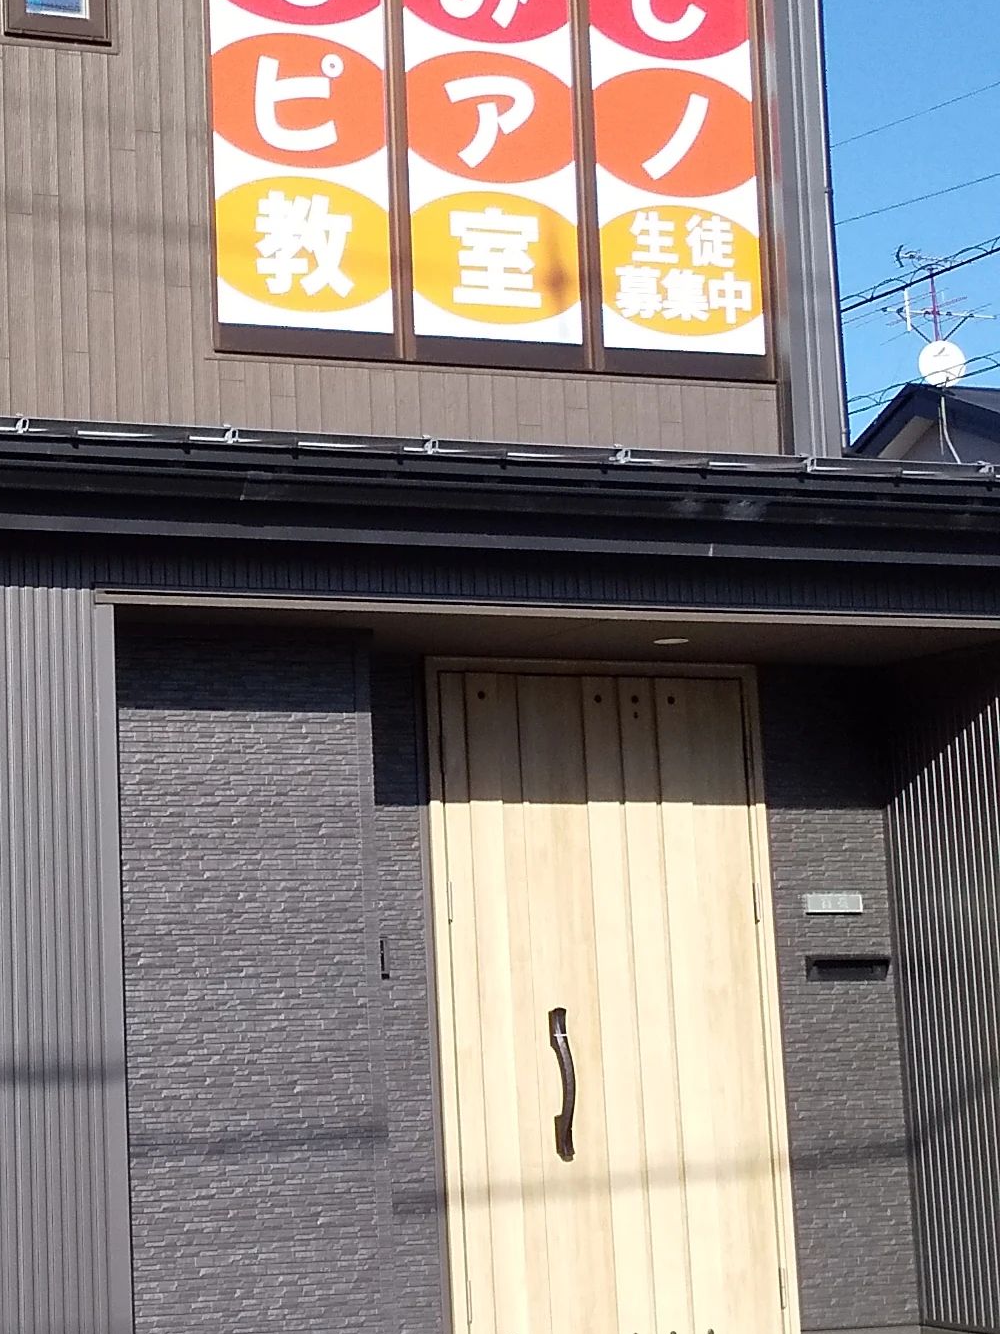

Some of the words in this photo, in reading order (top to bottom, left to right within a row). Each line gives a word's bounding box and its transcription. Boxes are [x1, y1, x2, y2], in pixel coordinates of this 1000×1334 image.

[254, 53, 709, 180] ピアノ
[255, 190, 542, 309] 教室
[629, 211, 735, 268] 生徒
[615, 265, 752, 324] 募集中
